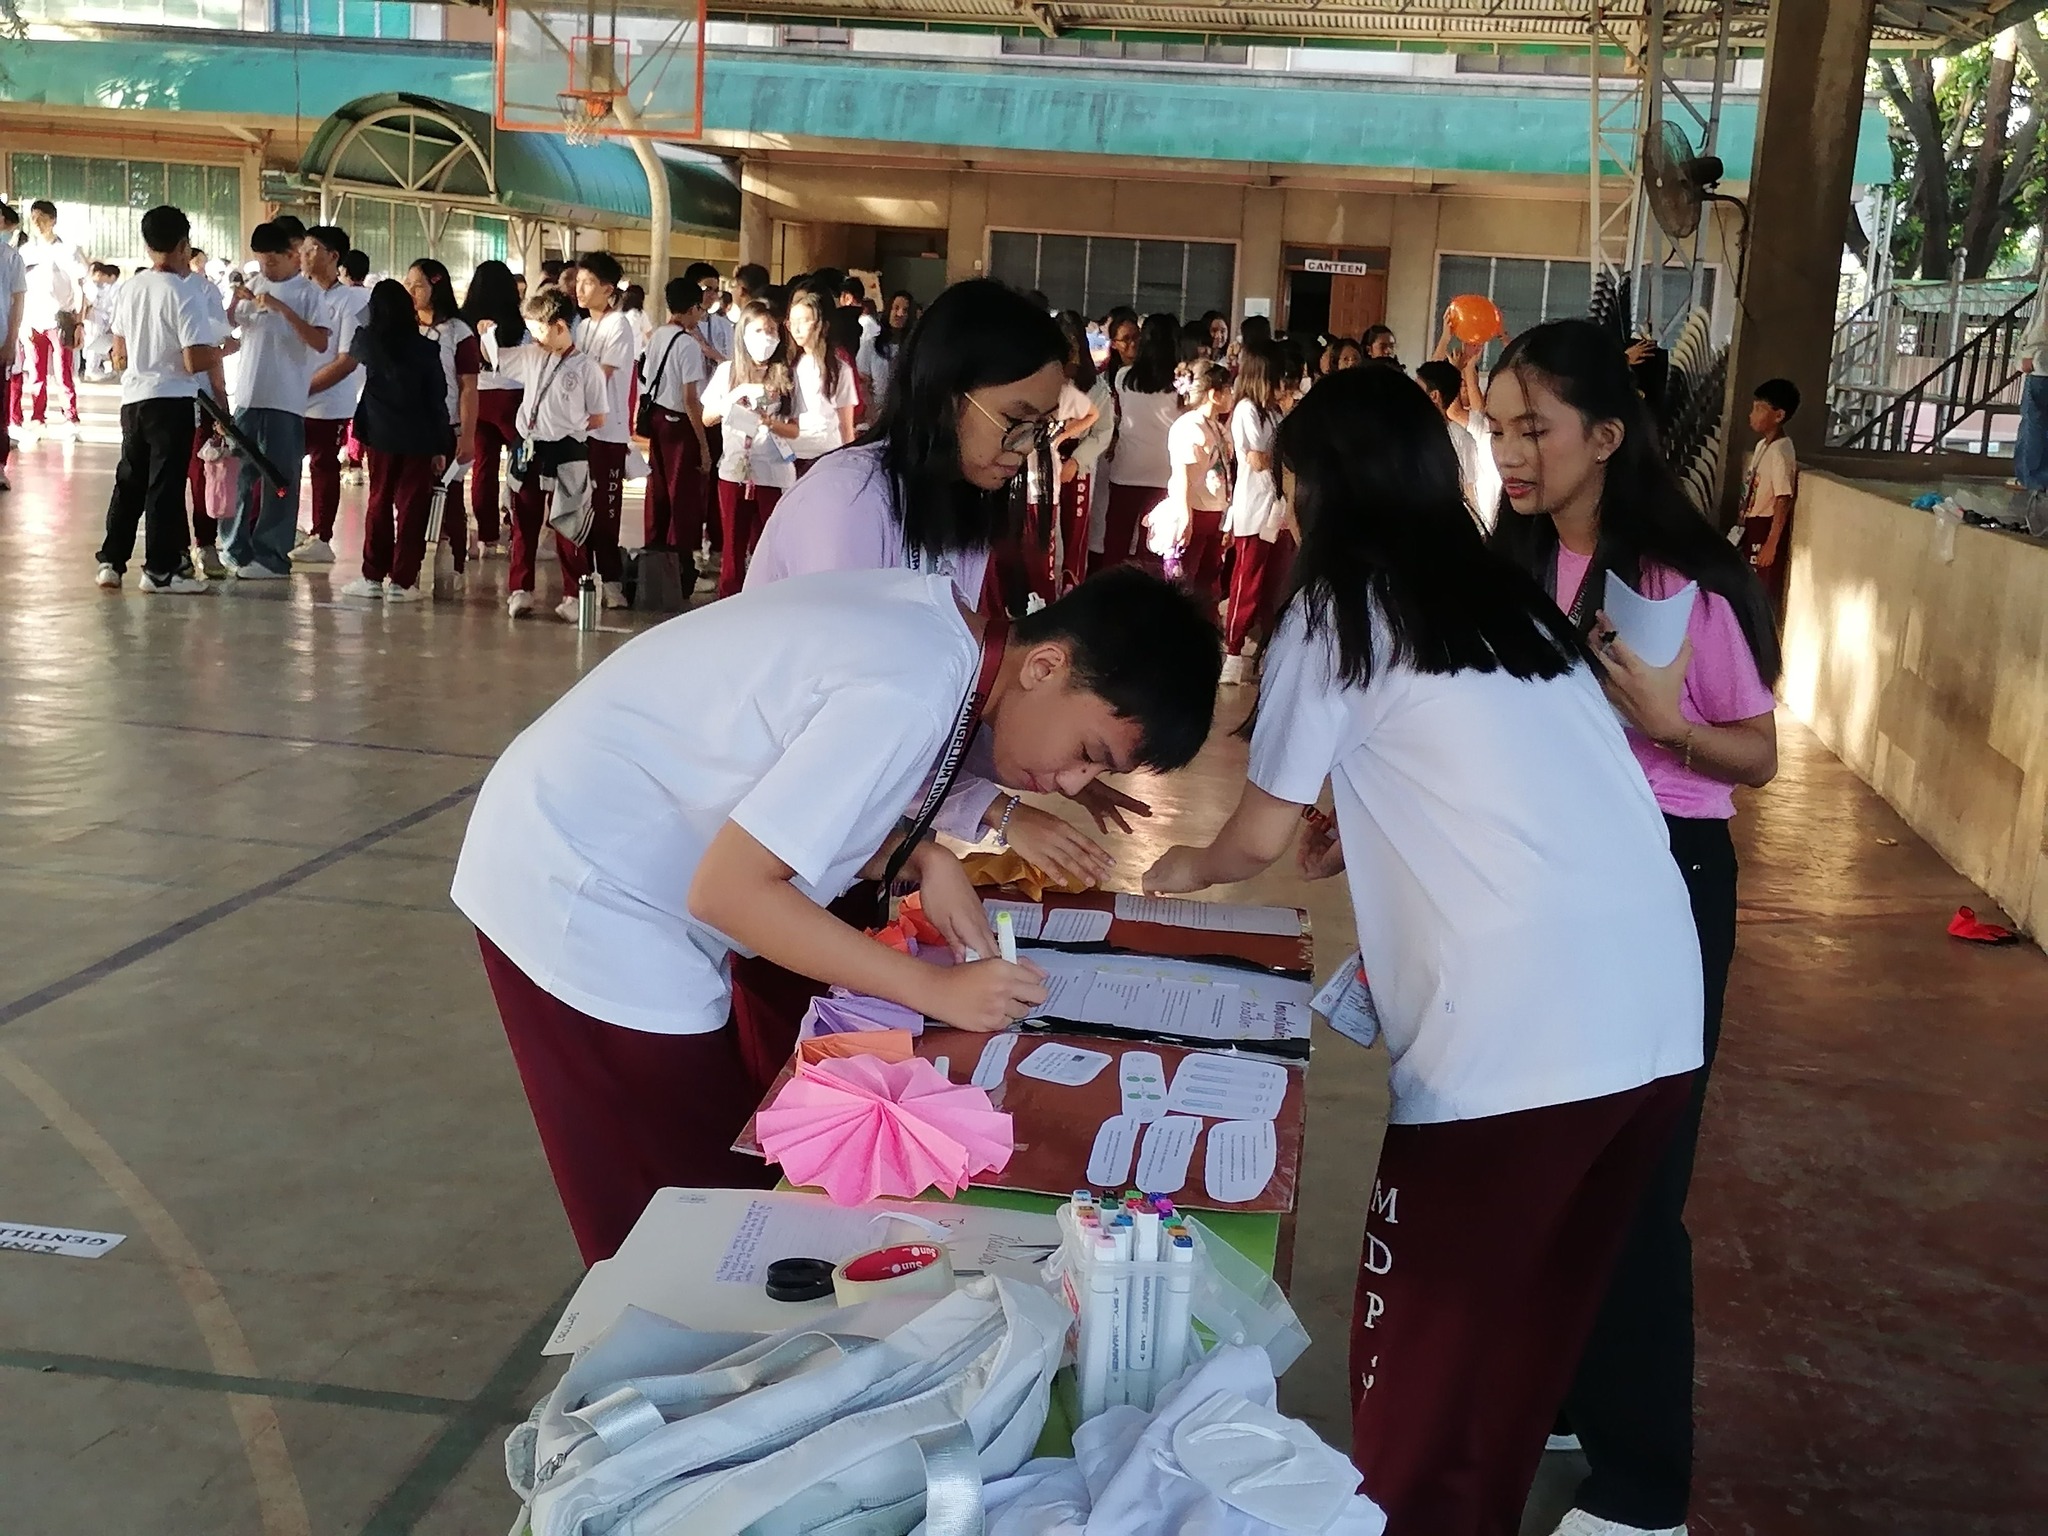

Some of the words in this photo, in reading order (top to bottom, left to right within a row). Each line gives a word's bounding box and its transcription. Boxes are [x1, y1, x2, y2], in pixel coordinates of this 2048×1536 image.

[1308, 261, 1363, 273] CANTEEN
[919, 1246, 937, 1258] Sun
[901, 1260, 923, 1270] Sun
